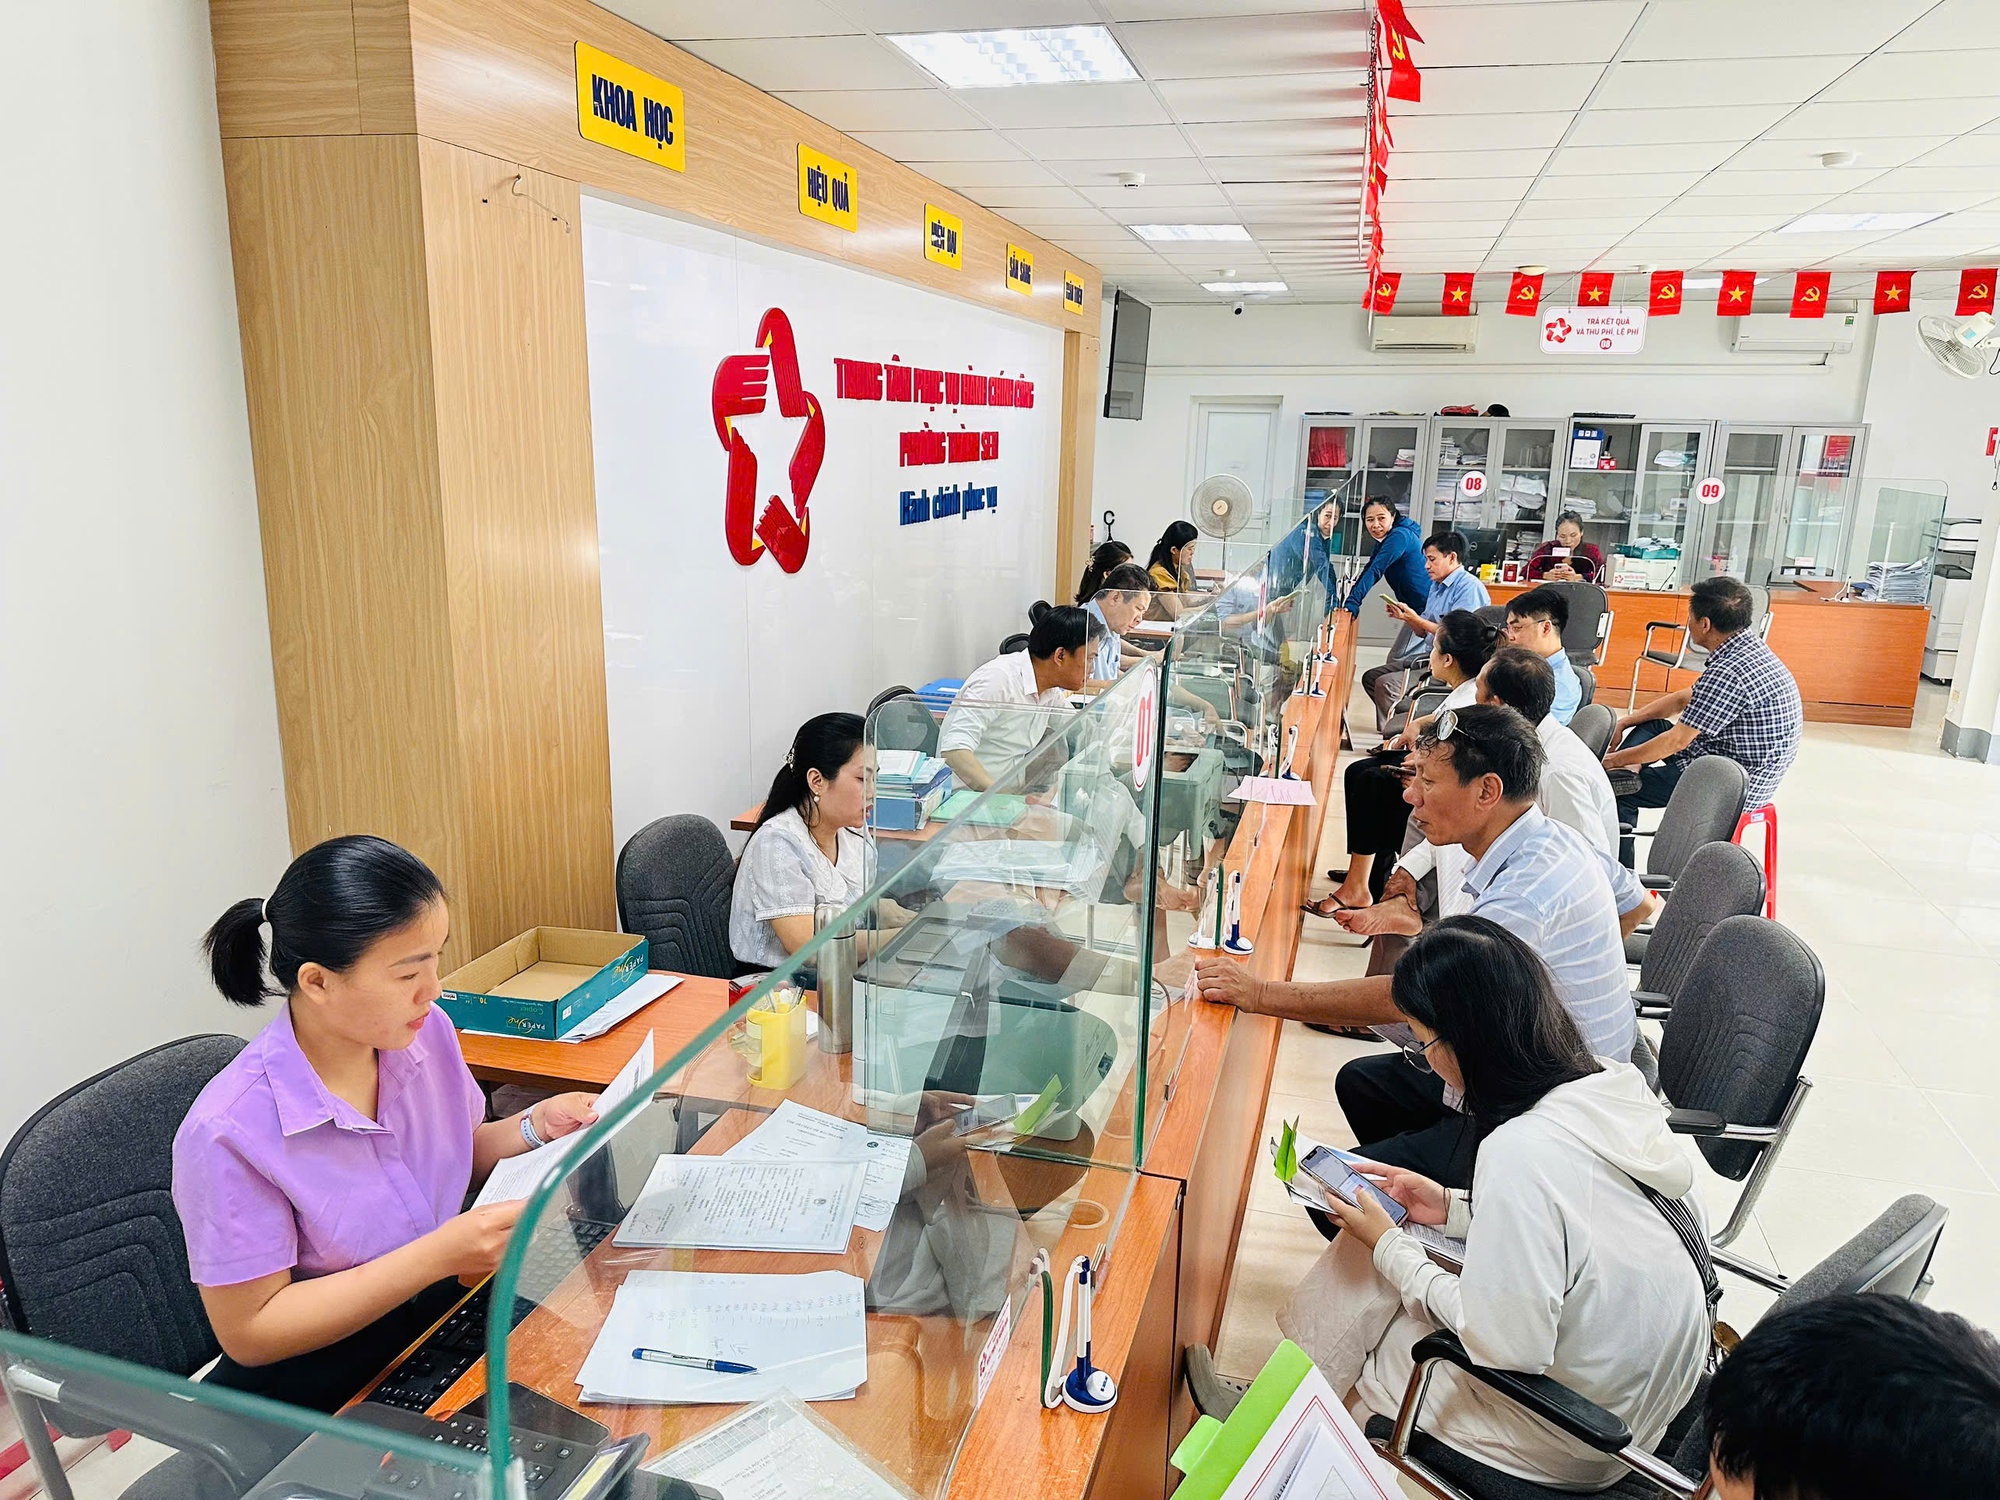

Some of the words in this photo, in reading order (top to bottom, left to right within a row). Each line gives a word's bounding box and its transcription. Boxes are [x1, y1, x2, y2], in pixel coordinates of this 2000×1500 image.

[591, 73, 637, 132] KHOA
[643, 96, 673, 150] HỌC
[807, 165, 828, 207] HIỆU
[832, 172, 850, 213] QUẢ
[1587, 317, 1600, 325] TRẢ
[1601, 317, 1614, 325] KẾT
[1615, 317, 1630, 326] QUẢ
[945, 371, 960, 414] VỤ
[932, 484, 960, 519] chính
[1466, 477, 1482, 491] 08
[1702, 484, 1720, 498] 09
